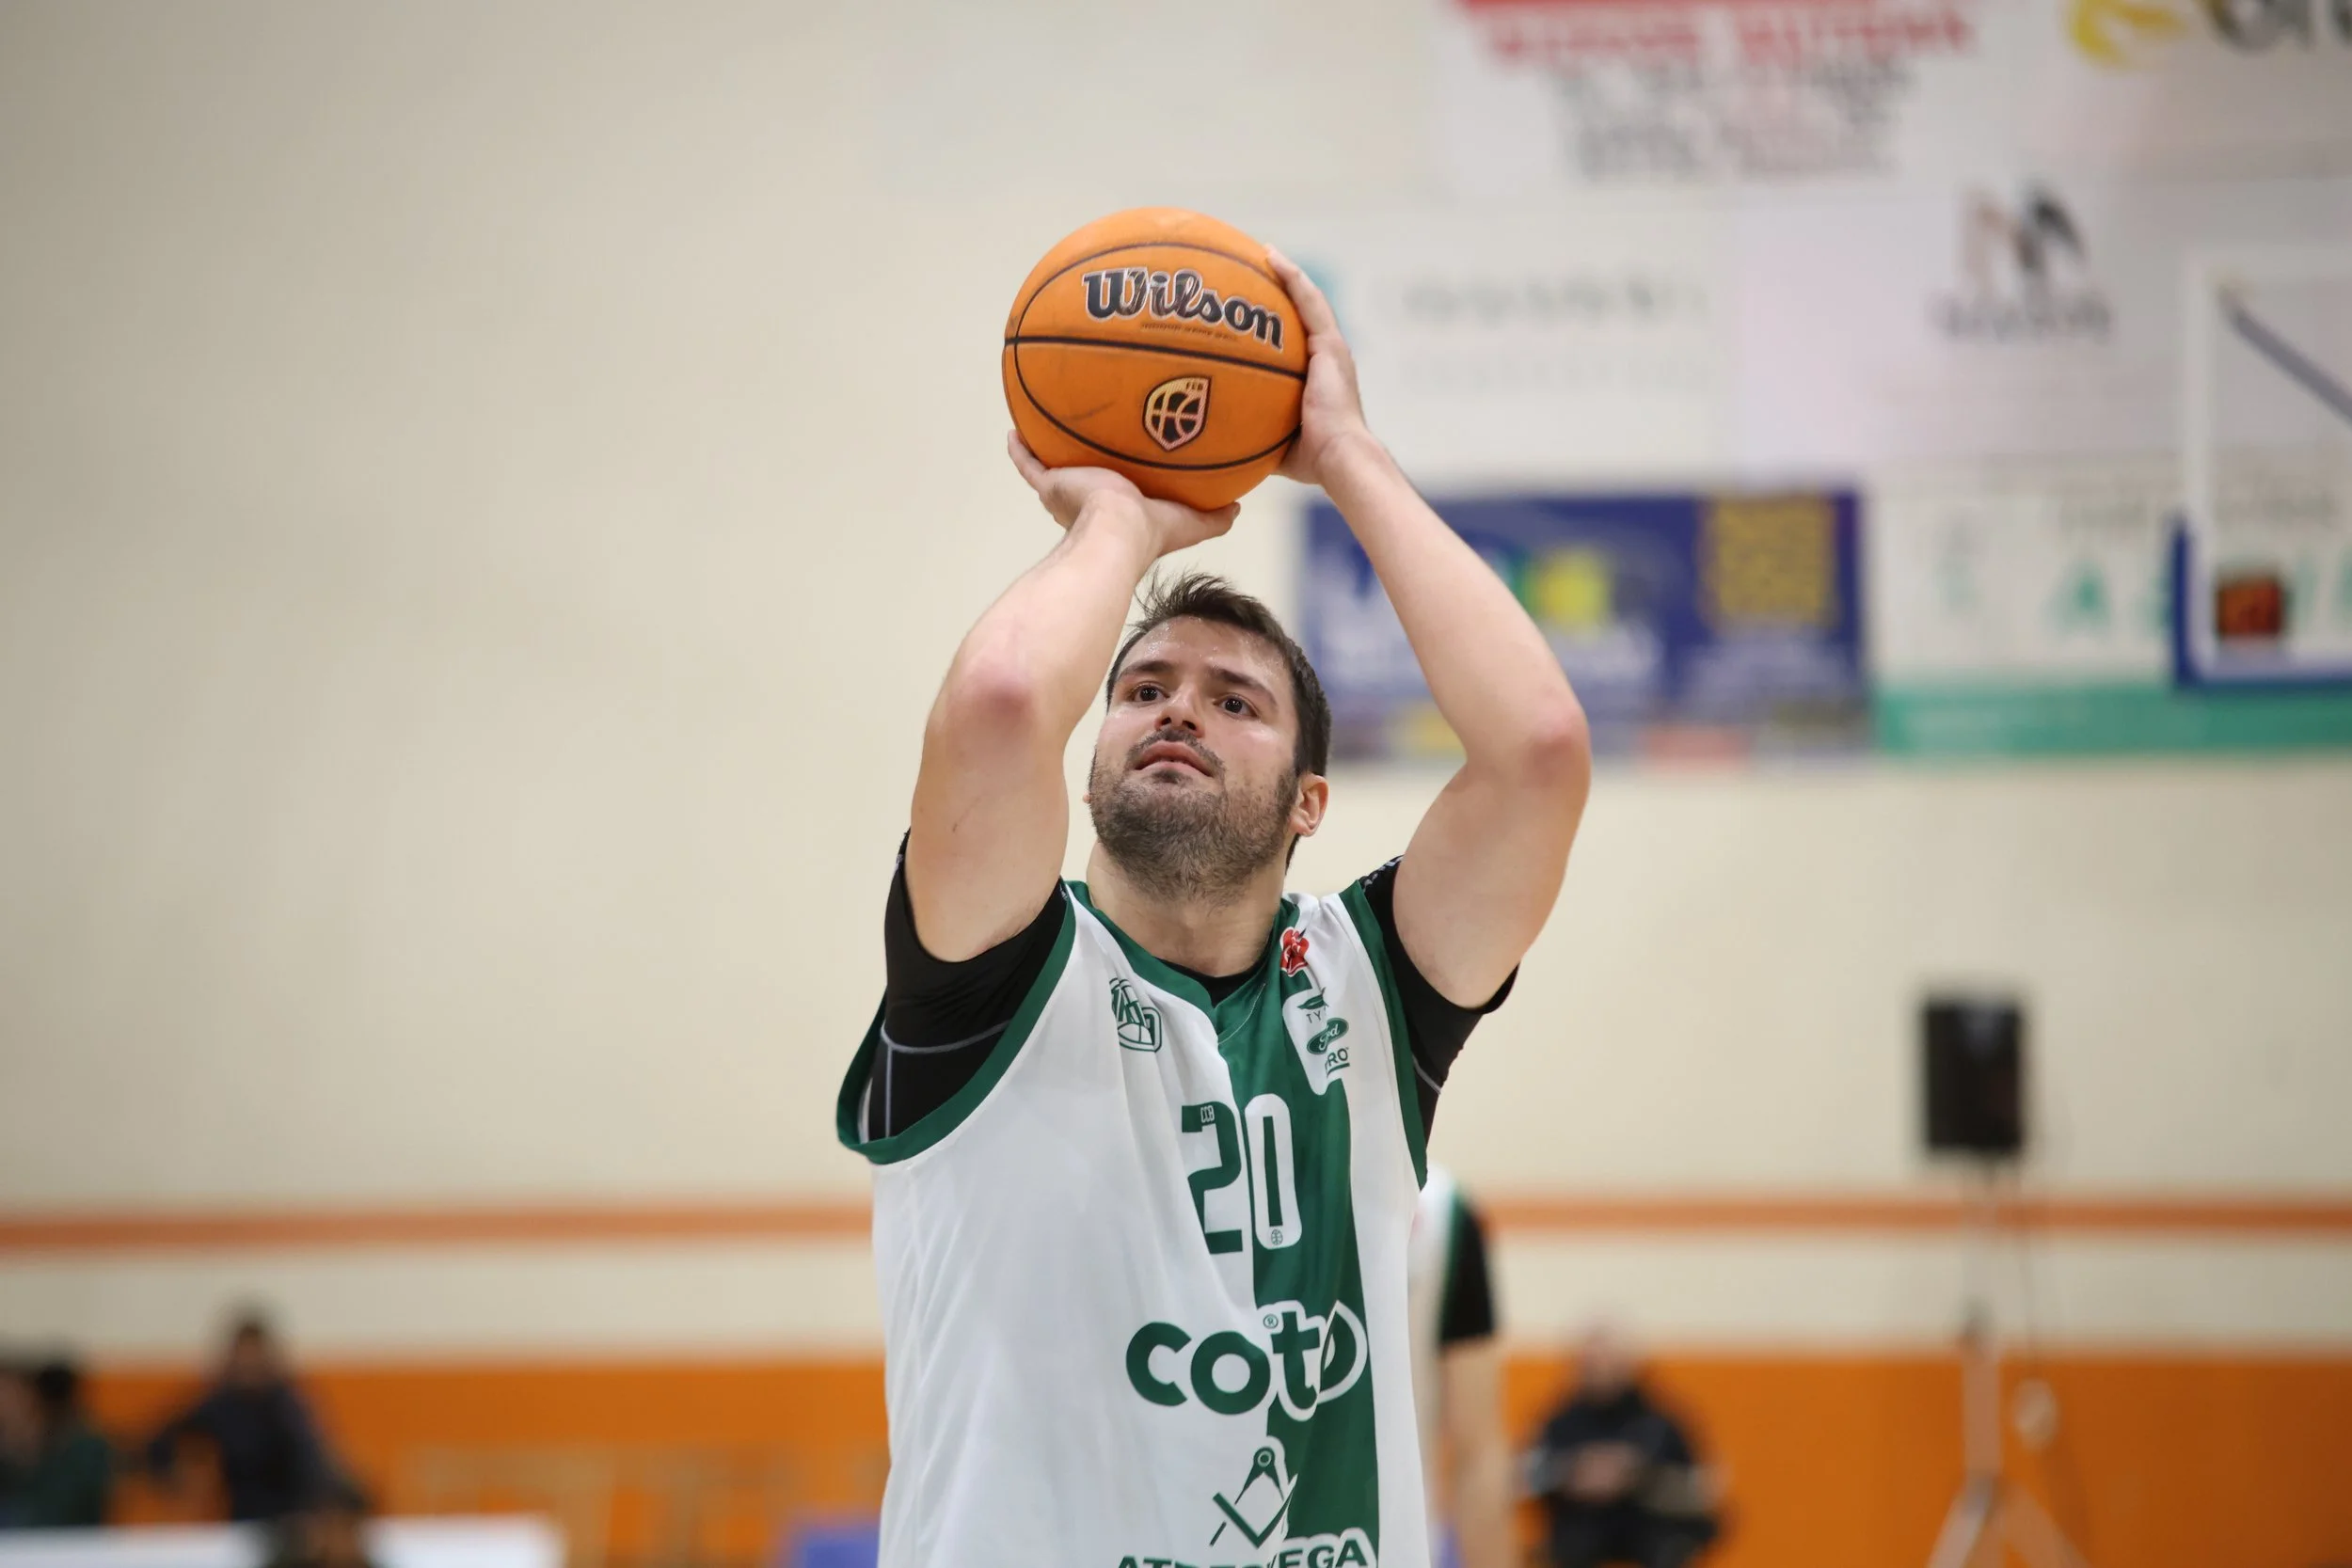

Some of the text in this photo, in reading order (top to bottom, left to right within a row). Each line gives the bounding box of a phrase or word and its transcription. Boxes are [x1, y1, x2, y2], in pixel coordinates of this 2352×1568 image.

[1082, 266, 1283, 351] Wilson
[1306, 1007, 1327, 1024] TY
[1182, 1093, 1302, 1255] 20
